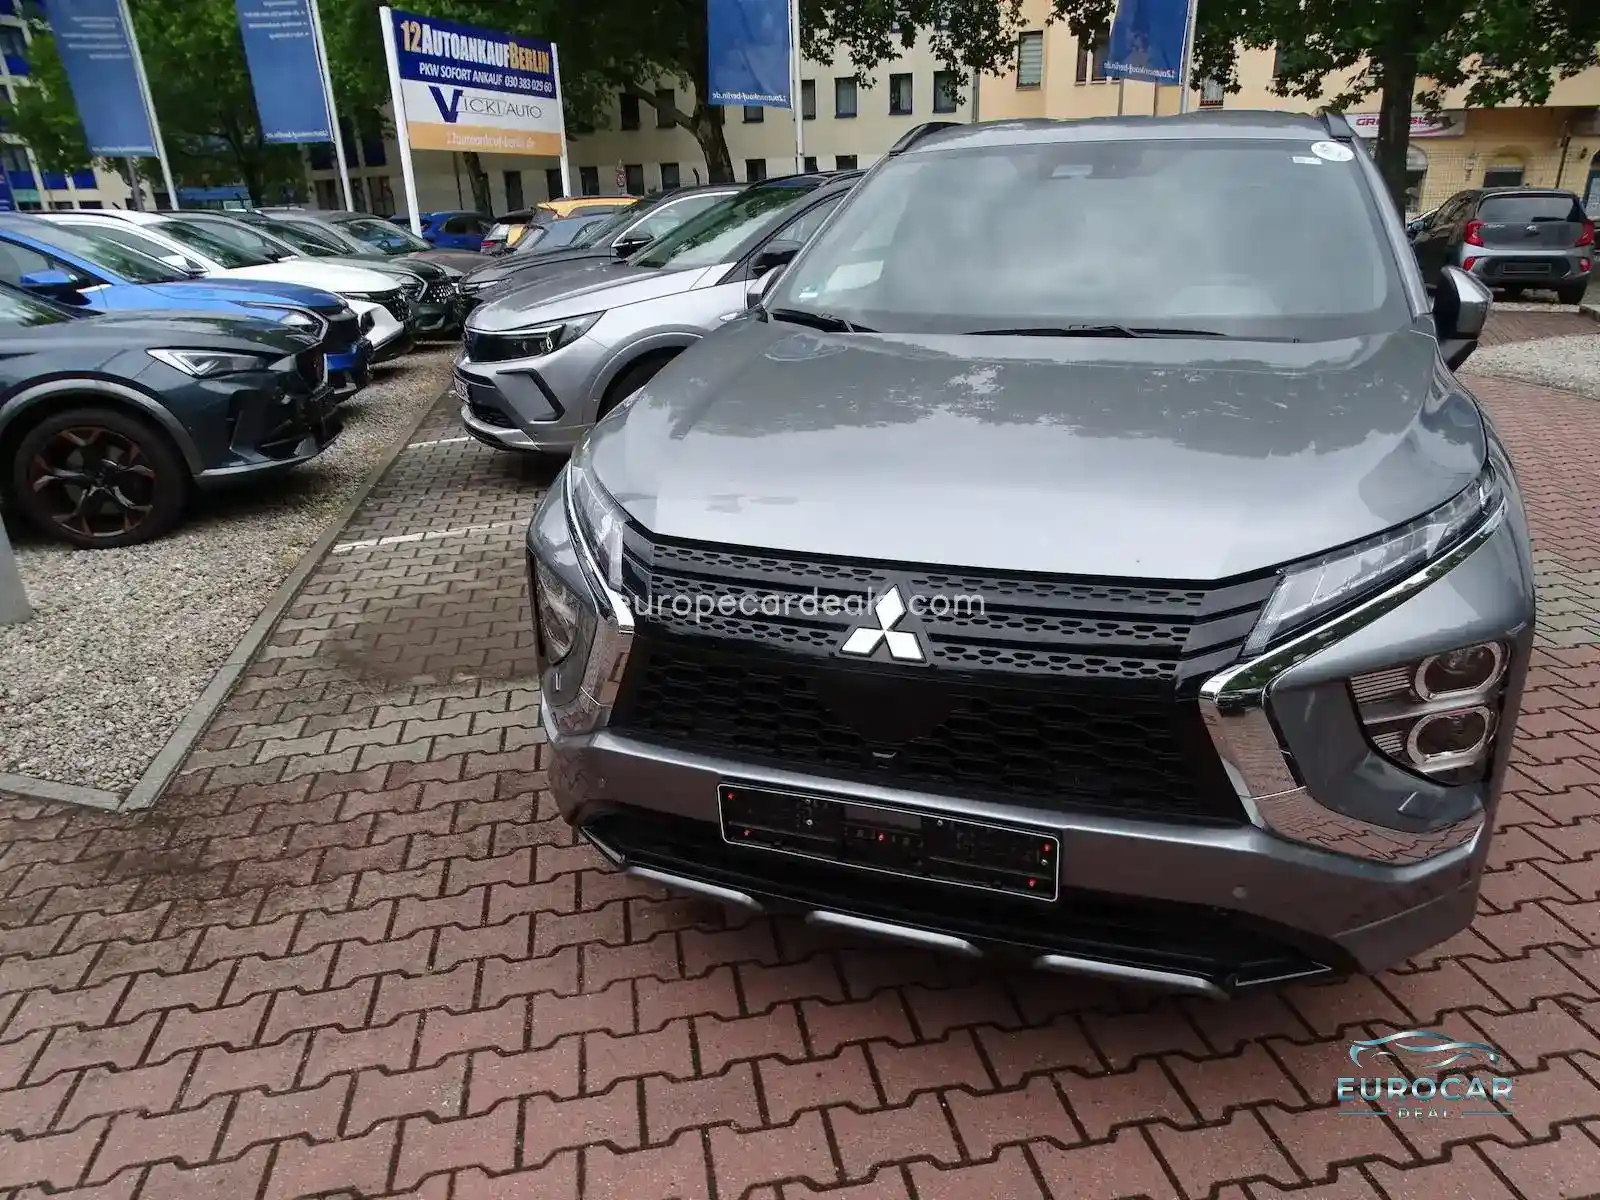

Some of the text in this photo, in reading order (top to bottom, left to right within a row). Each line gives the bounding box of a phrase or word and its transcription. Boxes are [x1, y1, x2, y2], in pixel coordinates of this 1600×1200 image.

[400, 20, 550, 74] 12AUTOANKAUFBERLIN
[419, 62, 553, 93] PKW SOFORT ANKAUF 030 383 029 60
[506, 103, 542, 119] AUTO
